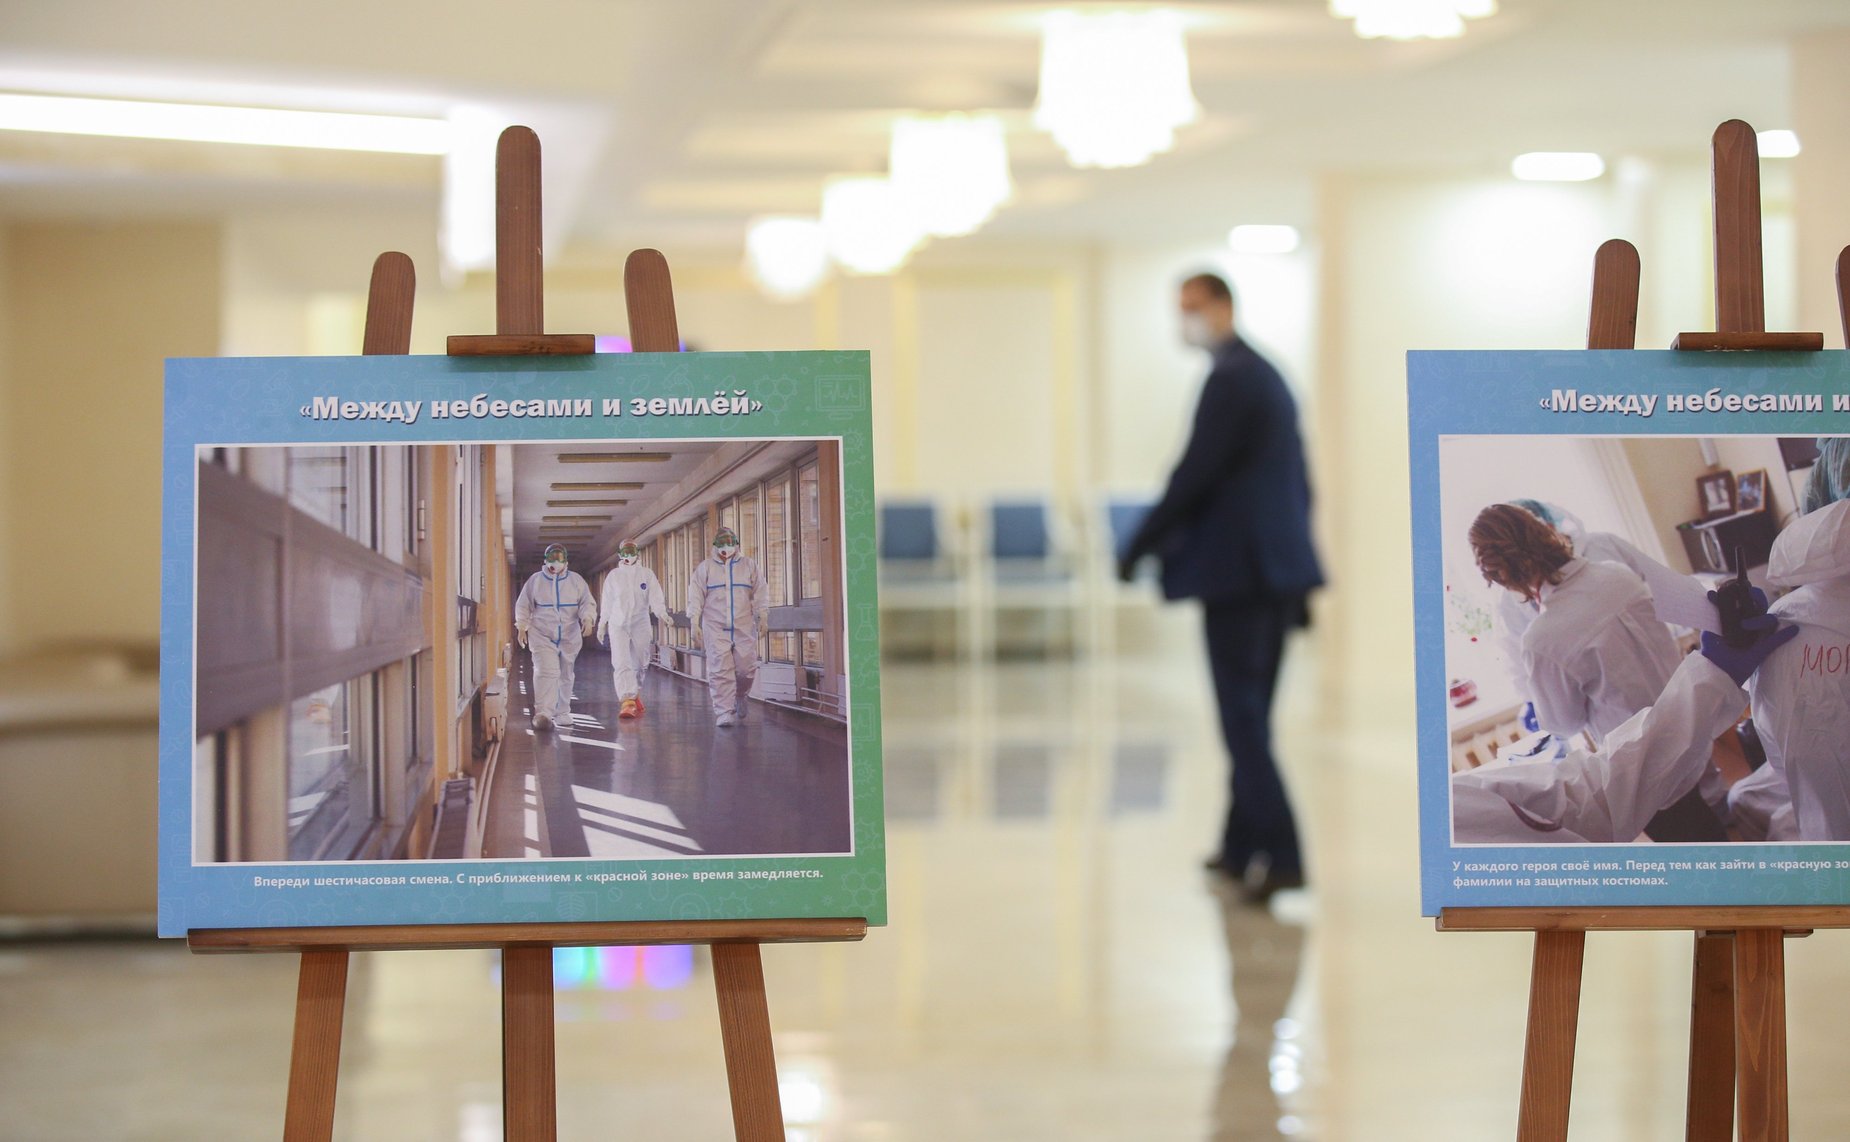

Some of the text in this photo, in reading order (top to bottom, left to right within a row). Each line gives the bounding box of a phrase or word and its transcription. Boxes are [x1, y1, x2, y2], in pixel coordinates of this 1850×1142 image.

[299, 389, 764, 424] «Между небесами и землёй»
[1538, 387, 1850, 418] «Между небесами и
[1452, 860, 1462, 872] У
[1464, 861, 1519, 873] каждого
[1521, 861, 1558, 873] героя
[1560, 860, 1591, 871] своё
[1592, 861, 1623, 871] имя.
[1625, 859, 1666, 872] Перед
[1668, 861, 1693, 870] тем
[1695, 861, 1717, 870] как
[1719, 858, 1756, 870] зайти
[1758, 861, 1767, 869] в
[1769, 860, 1832, 872] «красную
[253, 869, 825, 889] Впереди шестичасовая смена. С приближением к «красной зоне» время замедляется.
[1452, 875, 1669, 889] фамилии на защитных костюмах.
